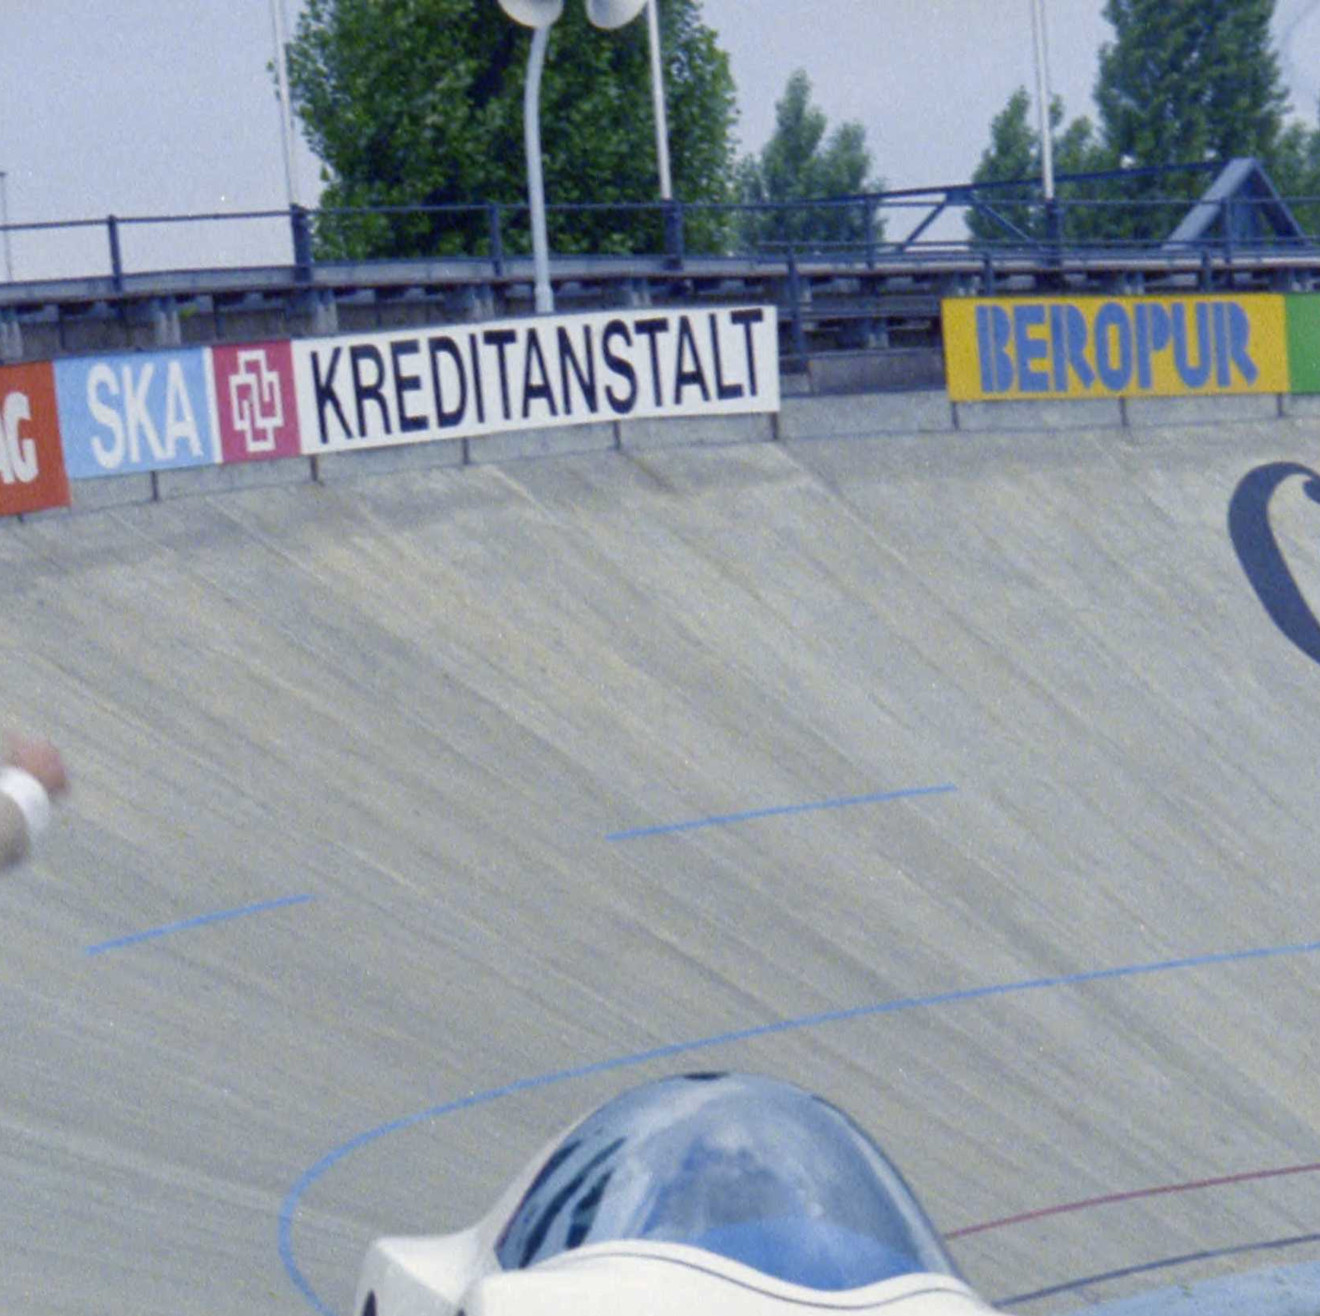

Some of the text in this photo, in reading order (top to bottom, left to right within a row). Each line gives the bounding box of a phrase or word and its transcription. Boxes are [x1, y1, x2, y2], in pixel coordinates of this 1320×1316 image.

[311, 308, 766, 445] KREDITANSTALT
[974, 301, 1260, 394] BEROPUR
[86, 362, 204, 467] SKA
